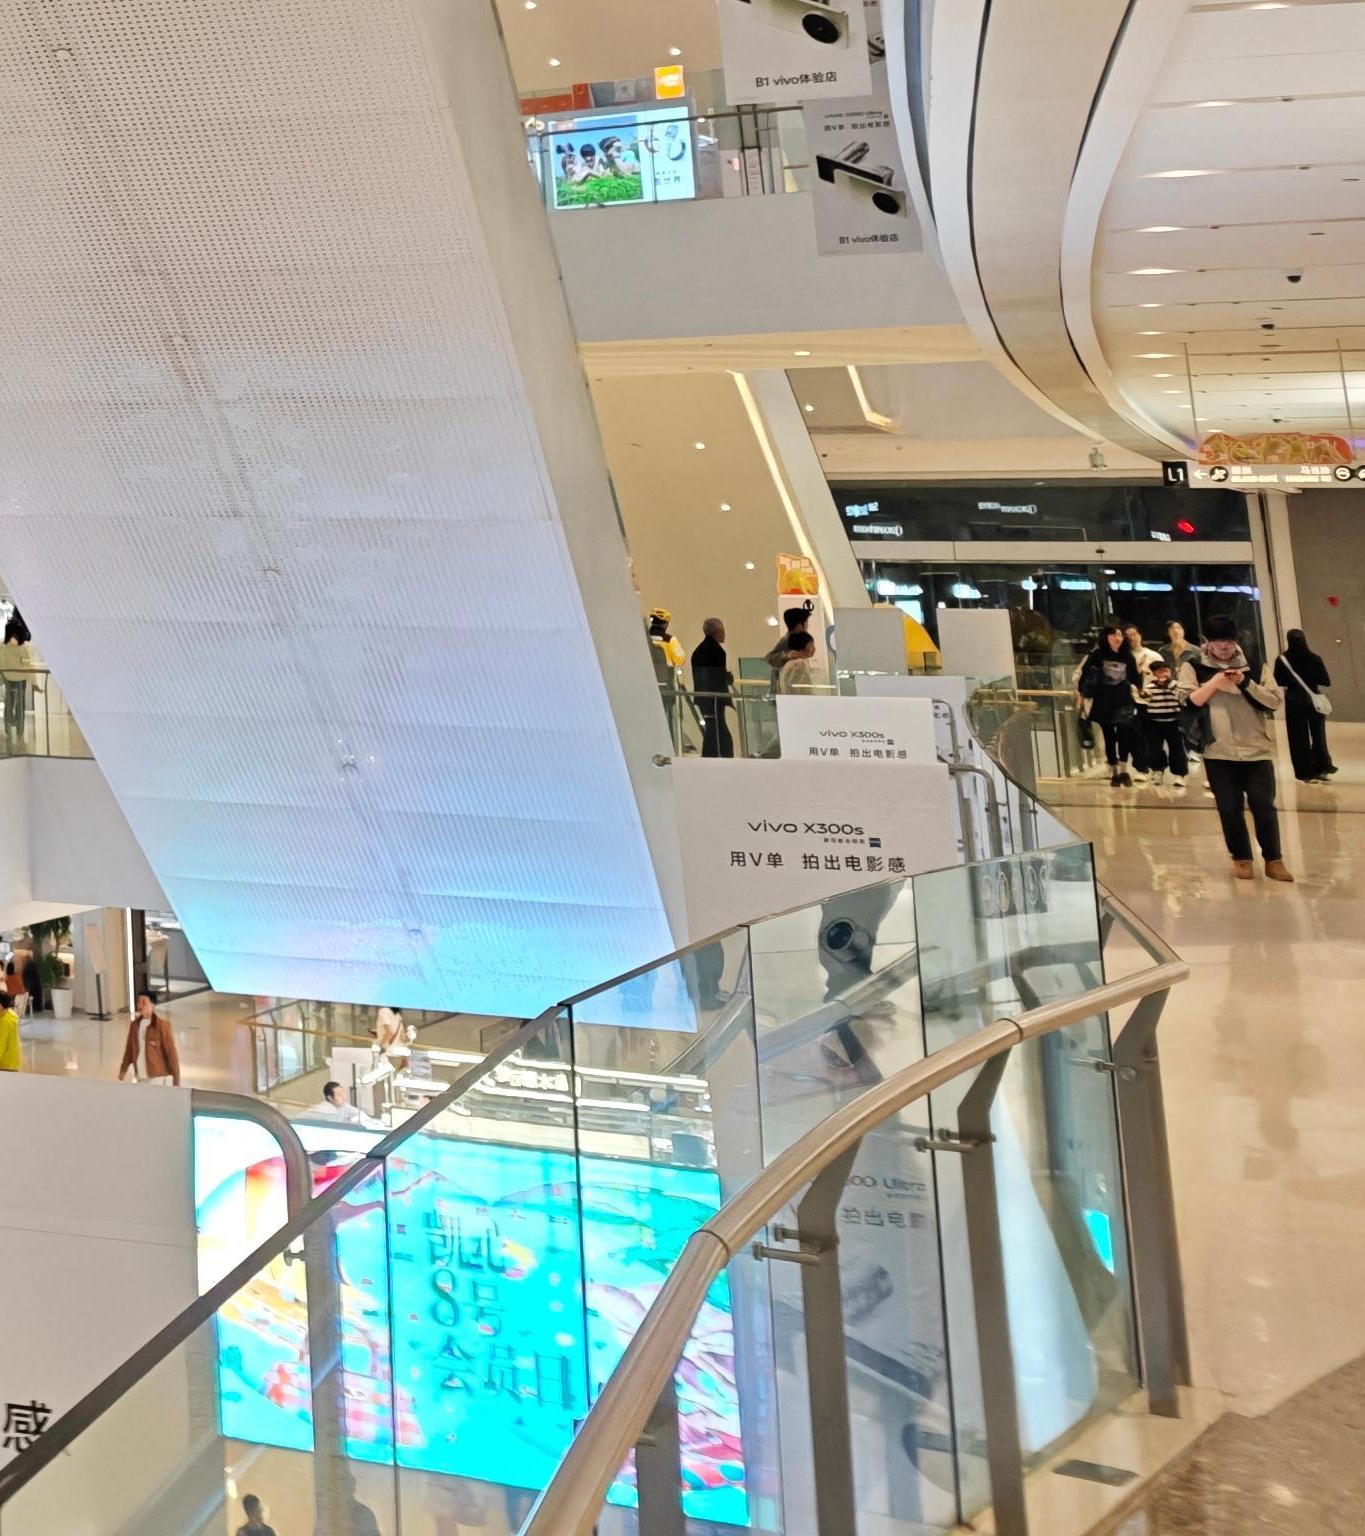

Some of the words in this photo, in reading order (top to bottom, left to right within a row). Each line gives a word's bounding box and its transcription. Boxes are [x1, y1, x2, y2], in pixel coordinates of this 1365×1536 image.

[755, 76, 769, 88] B1
[773, 71, 838, 87] vivo体验店
[1168, 467, 1184, 482] L1
[820, 729, 847, 738] vivo
[851, 731, 885, 739] X300s
[747, 819, 798, 833] vivo
[804, 822, 865, 836] X300s
[730, 851, 784, 868] 用V单
[801, 853, 906, 874] 拍出电影感
